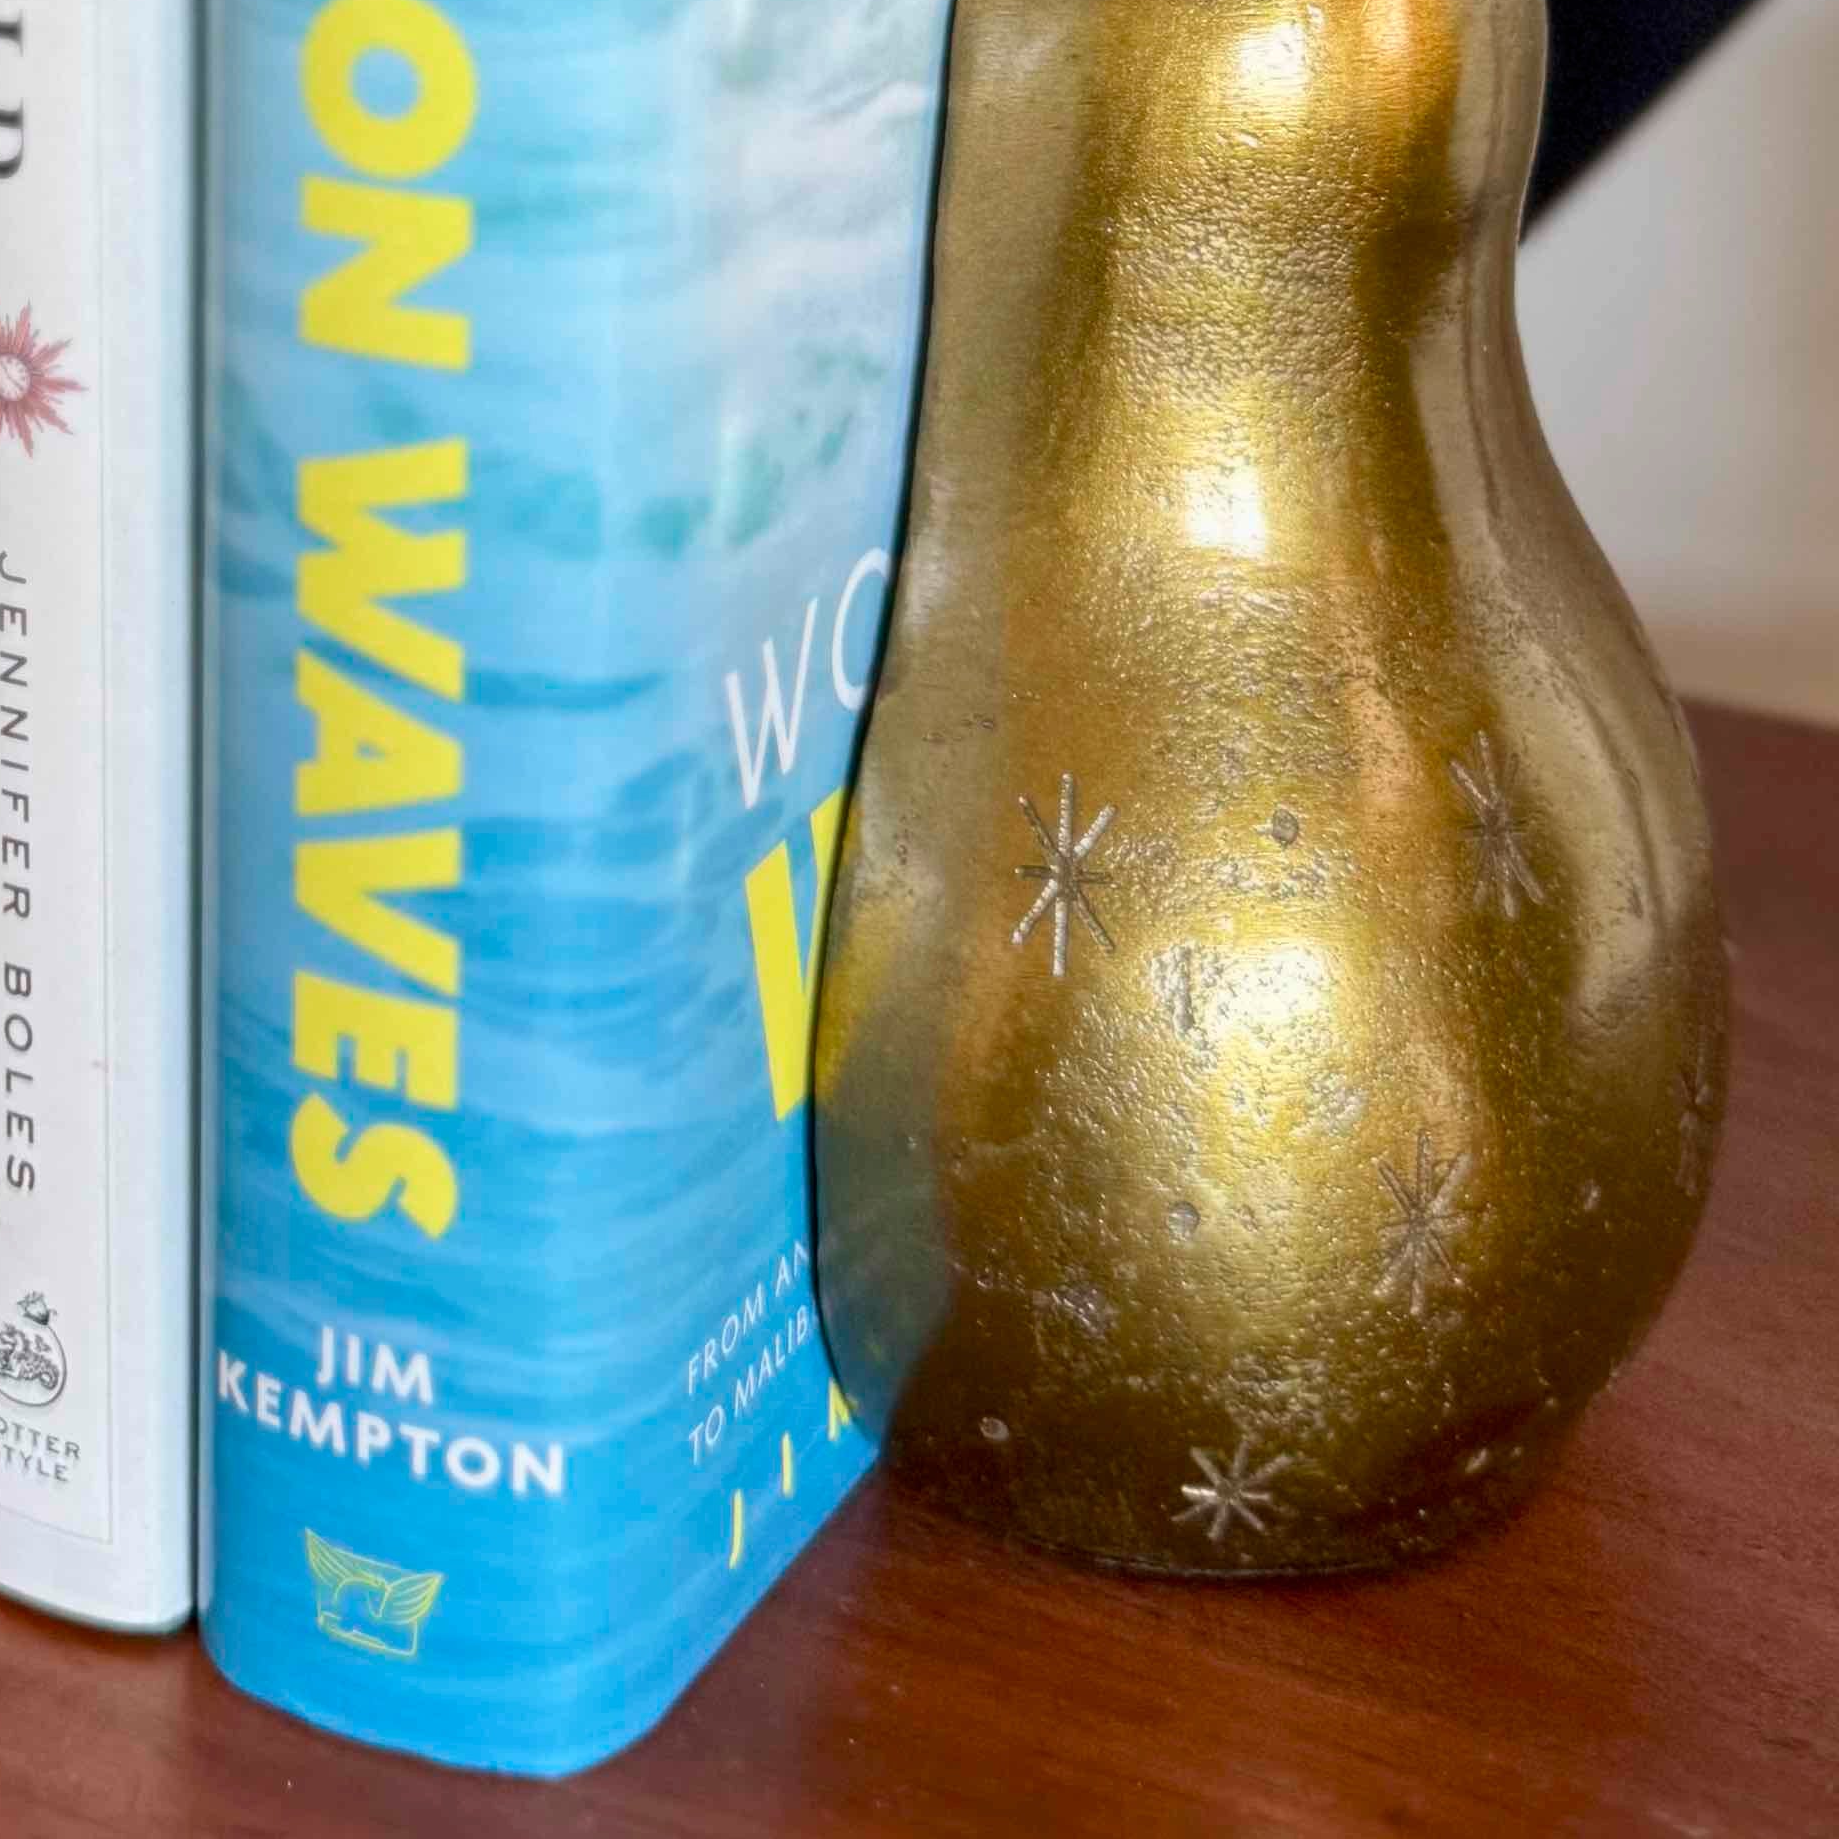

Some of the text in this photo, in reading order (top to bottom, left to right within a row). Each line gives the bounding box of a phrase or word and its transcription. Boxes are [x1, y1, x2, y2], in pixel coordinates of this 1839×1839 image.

[290, 436, 470, 1242] WAVES
[3, 960, 36, 1193] BOLES
[316, 1325, 434, 1406] JIM
[688, 1282, 765, 1397] FROM
[217, 1349, 565, 1497] KEMPTON
[688, 1405, 726, 1465] TO
